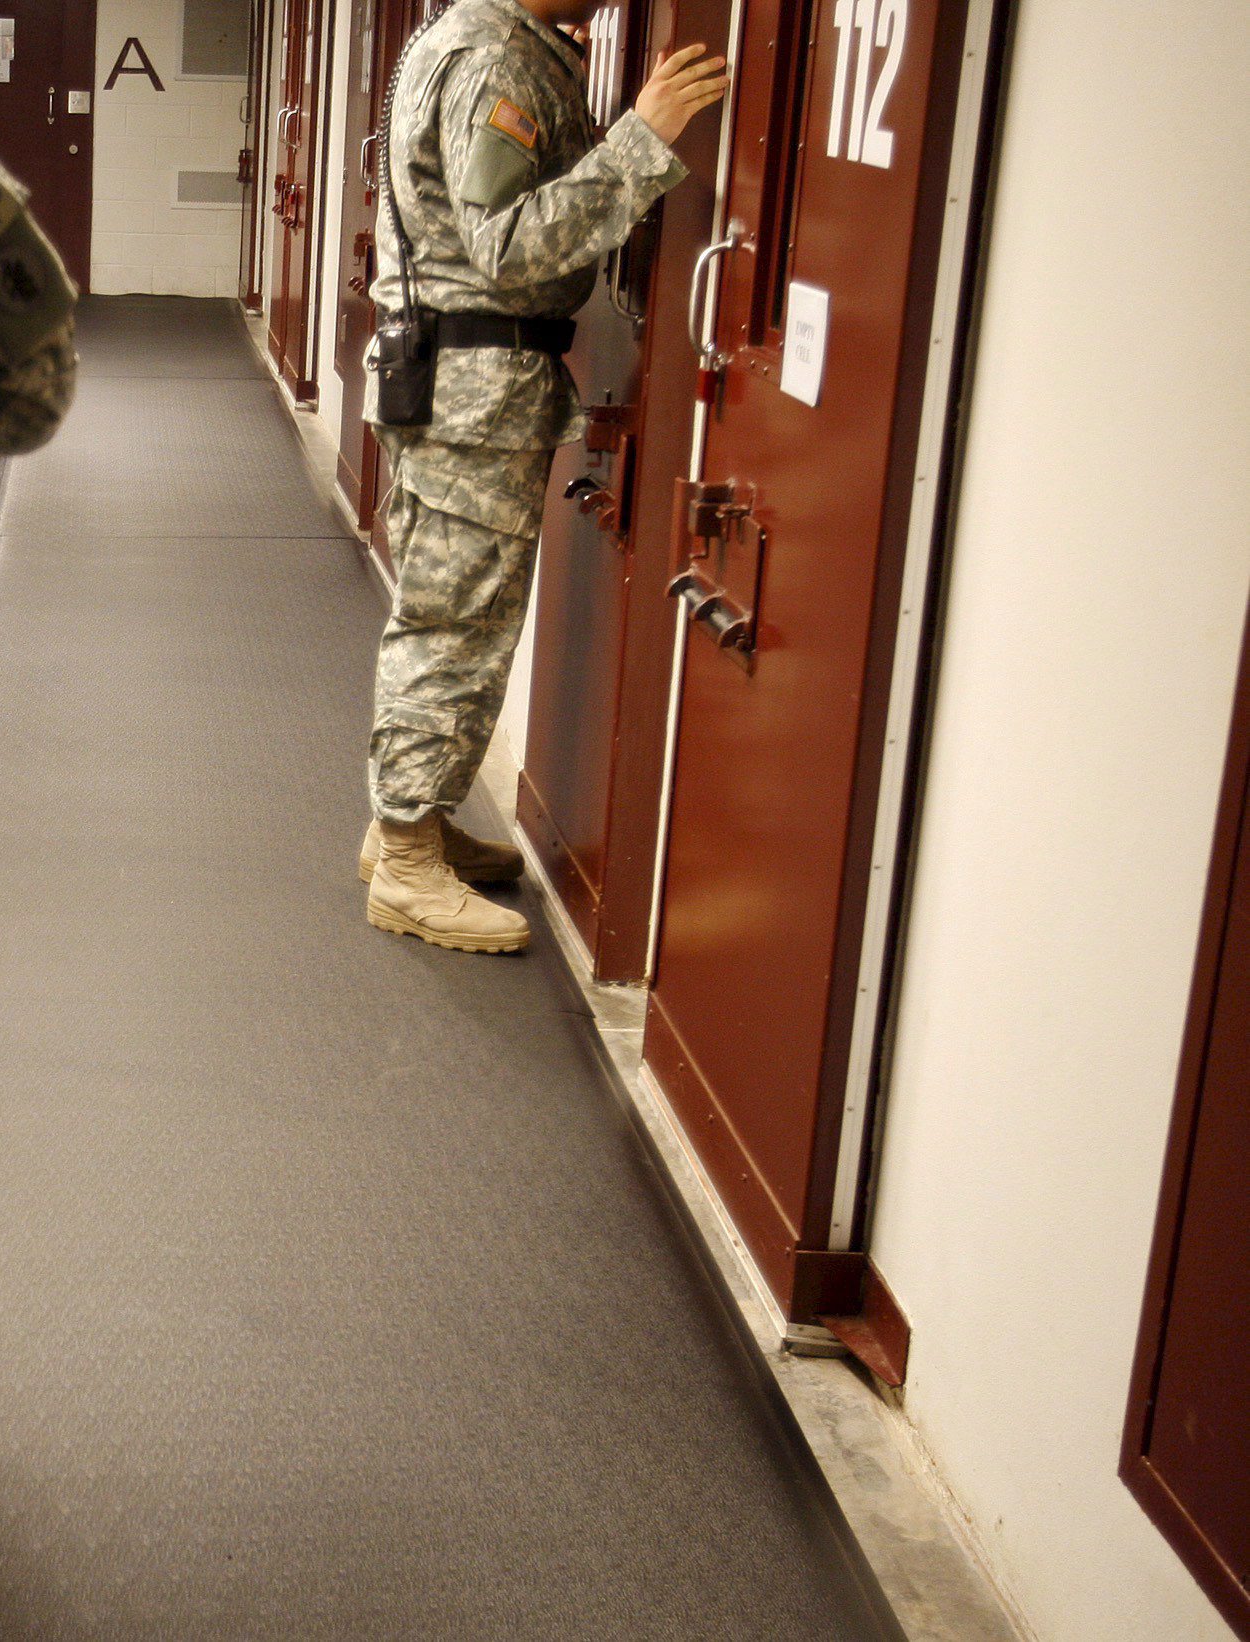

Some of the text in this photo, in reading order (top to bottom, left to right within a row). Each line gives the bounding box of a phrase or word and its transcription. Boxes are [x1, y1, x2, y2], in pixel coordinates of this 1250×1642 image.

[103, 37, 165, 92] A
[587, 7, 619, 126] 111
[827, 0, 907, 169] 112
